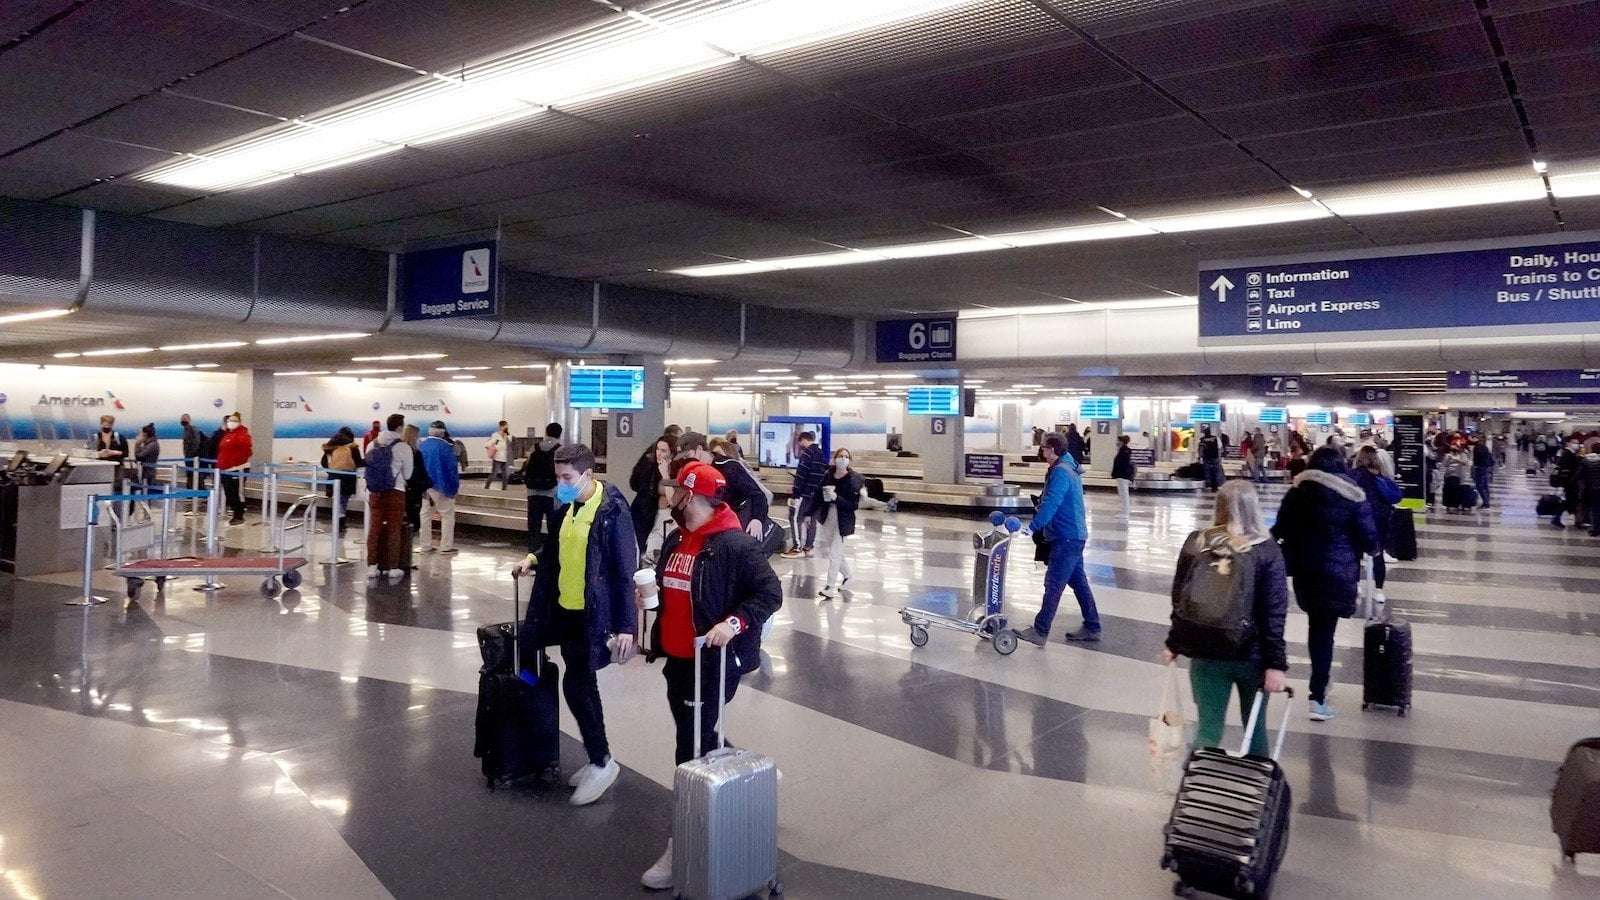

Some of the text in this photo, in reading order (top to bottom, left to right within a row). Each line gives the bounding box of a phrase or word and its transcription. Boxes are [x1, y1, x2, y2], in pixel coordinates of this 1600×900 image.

[1510, 254, 1559, 268] Daily,
[1266, 269, 1350, 284] Information
[1502, 272, 1558, 285] Trains
[1563, 271, 1582, 282] to
[1267, 287, 1296, 299] Taxi
[1497, 291, 1531, 303] Bus
[1535, 289, 1543, 301] /
[421, 299, 489, 315] Baggage Service
[1267, 300, 1380, 315] Airport Express
[1266, 319, 1301, 330] Limo
[909, 322, 926, 350] 6
[1272, 377, 1282, 391] 7
[38, 394, 104, 406] American
[399, 402, 439, 411] American
[620, 416, 630, 434] 6
[933, 420, 943, 433] 6
[1099, 422, 1108, 433] 7
